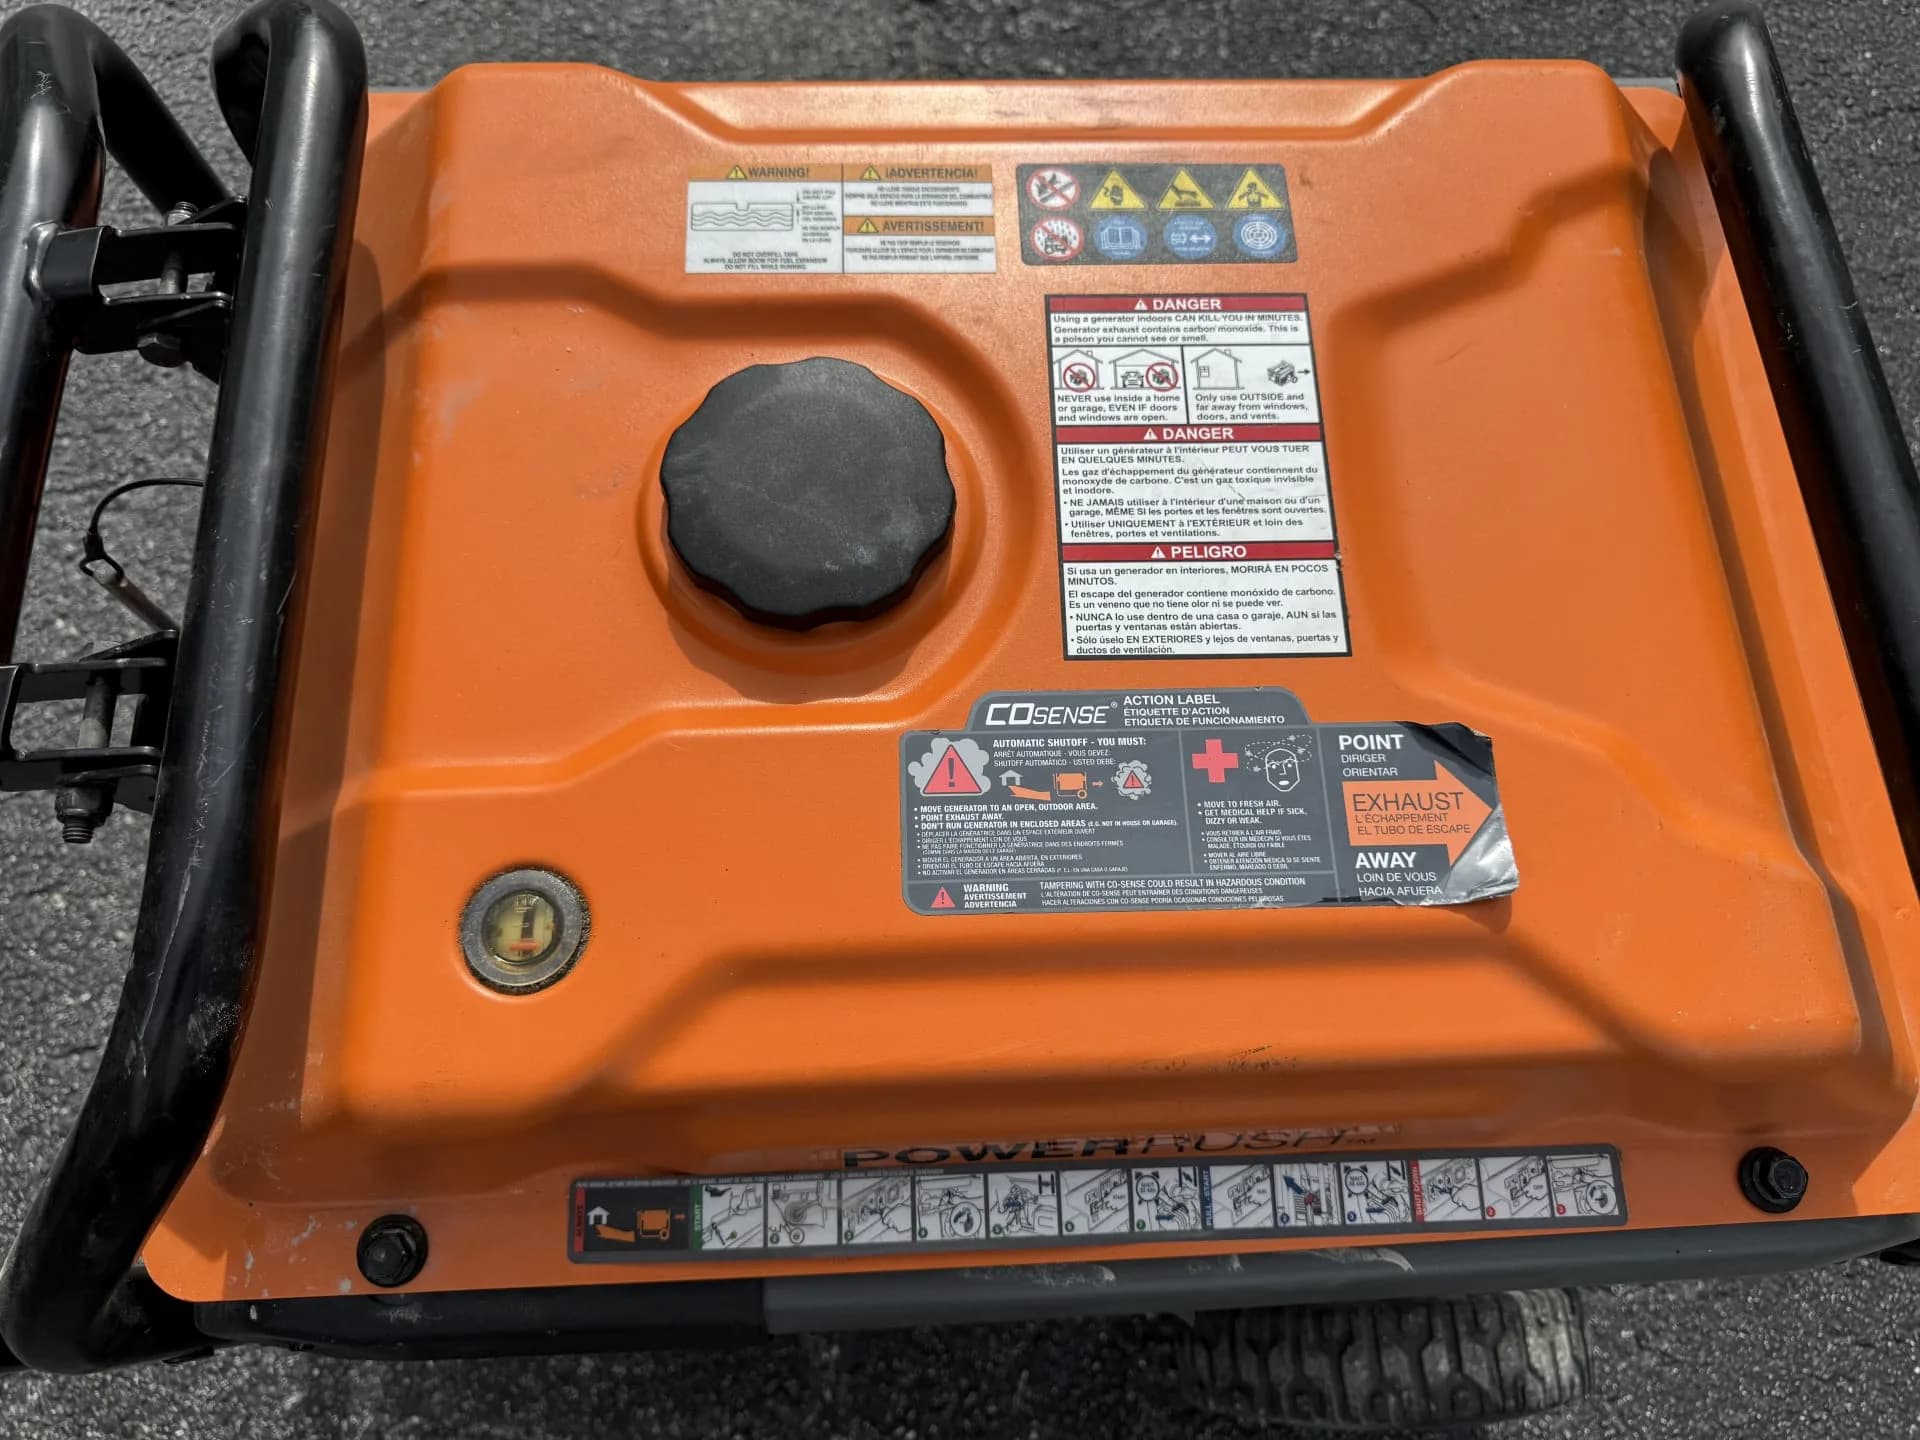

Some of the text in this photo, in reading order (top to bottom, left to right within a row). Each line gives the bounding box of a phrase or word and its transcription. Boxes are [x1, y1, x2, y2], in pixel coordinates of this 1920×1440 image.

[748, 167, 809, 178] WARNING!
[882, 220, 984, 232] AVERTISSEMENT!
[1152, 298, 1222, 310] DANGER
[1053, 315, 1080, 324] Using
[1090, 315, 1134, 323] generator
[1174, 314, 1196, 322] CAN
[1197, 314, 1220, 322] KILL
[1217, 324, 1265, 332] monoxide.
[1269, 324, 1288, 332] This
[1062, 335, 1094, 343] poison
[1096, 336, 1114, 344] you
[1057, 394, 1091, 402] NEVER
[1113, 394, 1142, 402] inside
[1195, 393, 1217, 403] Only
[1239, 392, 1284, 401] OUTSIDE
[1070, 405, 1106, 413] garage,
[1108, 403, 1135, 411] EVEN
[1138, 403, 1146, 411] IF
[1149, 403, 1177, 411] doors
[1195, 402, 1309, 412] far away from windows,
[1229, 412, 1248, 420] and
[1162, 427, 1234, 440] DANGER
[1221, 445, 1247, 453] PEUT
[1250, 445, 1279, 453] VOUS
[1283, 444, 1309, 452] TUER
[1078, 455, 1134, 463] QUELQUES
[1136, 455, 1186, 463] MINUTES.
[1171, 545, 1247, 558] PELIGRO
[1067, 567, 1077, 575] Si
[1113, 567, 1163, 576] generador
[1179, 566, 1229, 574] interiores,
[1274, 564, 1289, 573] EN
[1291, 564, 1328, 572] POCOS
[1067, 577, 1117, 585] MINUTOS.
[1075, 624, 1112, 632] puertas
[1114, 624, 1120, 632] y
[1199, 622, 1242, 630] abiertas.
[1123, 694, 1220, 705] ACTION LABEL
[1181, 706, 1230, 718] D'ACTION
[1124, 715, 1285, 726] ETIQUETA DE FUNCIONAMIENTO
[993, 737, 1147, 747] AUTOMATIC SHUTOFF YOU MUST:
[1338, 734, 1404, 750] POINT
[1340, 753, 1386, 763] DIRIGER
[1342, 767, 1398, 776] ORIENTAR
[1203, 800, 1225, 808] MOVE
[1352, 791, 1464, 812] EXHAUST
[920, 805, 941, 814] MOVE
[943, 804, 987, 813] GENERATOR
[990, 804, 999, 813] TO
[1038, 802, 1073, 810] OUTDOOR
[1204, 808, 1218, 816] GET
[1277, 807, 1284, 815] IF
[920, 813, 942, 822] POINT
[945, 813, 979, 822] EXHAUST
[945, 821, 961, 829] RUN
[963, 820, 1007, 829] GENERATOR
[1019, 819, 1058, 828] ENCLOSED
[1060, 819, 1085, 827] AREAS
[1357, 824, 1471, 835] EL TUBO DE ESCAPE
[1355, 851, 1416, 869] AWAY
[1356, 871, 1437, 882] LOIN DE VOUS
[963, 883, 1009, 894] WARNING
[1040, 877, 1306, 891] TAMPERING WITH CO-SENSE COULD RESULT IN HAZARDOUS CONDITION
[964, 892, 1027, 900] AVERTISSEMENT
[1358, 885, 1444, 897] HACIA AFUERA
[964, 900, 1017, 908] ADVERTENCIA
[1415, 1193, 1425, 1217] SHUT
[693, 1202, 702, 1232] START
